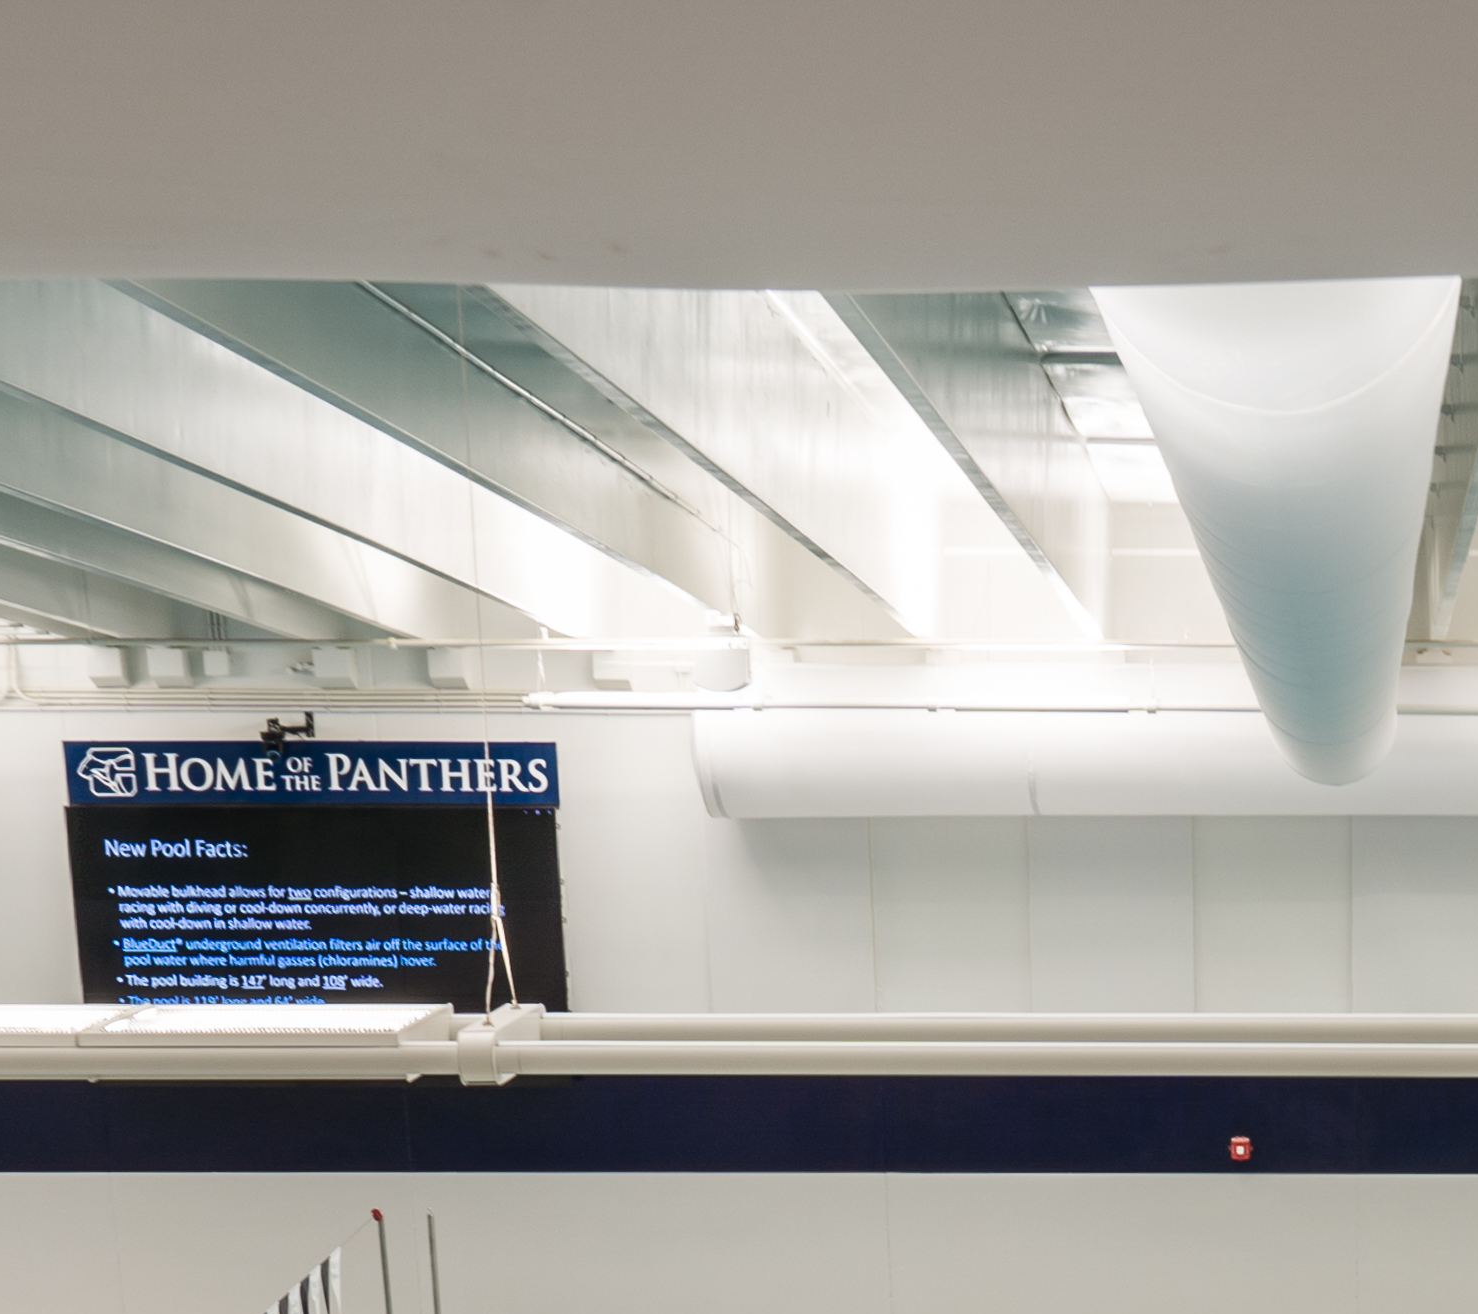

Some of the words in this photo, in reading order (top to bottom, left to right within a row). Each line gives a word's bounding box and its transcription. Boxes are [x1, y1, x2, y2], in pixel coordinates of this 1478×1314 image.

[140, 752, 277, 792] HOME
[286, 757, 313, 773] OF
[324, 753, 550, 793] PANTHERS
[280, 774, 322, 792] THE
[104, 838, 146, 858] New
[150, 838, 192, 858] Pool
[195, 838, 249, 858] Facts:
[117, 885, 170, 899] Movable
[172, 885, 227, 899] bulkhead
[228, 885, 266, 899] allows
[268, 885, 285, 899] for
[288, 887, 312, 899] two
[314, 885, 398, 901] configurations
[409, 886, 455, 899] shallow
[457, 886, 491, 899] water
[119, 901, 156, 916] racing
[157, 901, 184, 914] with
[186, 901, 223, 916] diving
[224, 904, 237, 914] or
[239, 901, 302, 914] cool-down
[304, 901, 382, 917] concurrently,
[383, 904, 397, 914] or
[398, 901, 466, 917] deep-water
[469, 902, 506, 917] racig
[119, 917, 148, 930] with
[149, 917, 212, 930] cool-down
[214, 917, 226, 930] in
[228, 917, 273, 930] shallow
[274, 918, 312, 930] water.
[185, 937, 262, 953] underground
[263, 938, 327, 951] ventilation
[329, 938, 363, 951] filters
[365, 938, 381, 951] air
[383, 938, 401, 951] off
[402, 938, 422, 951] the
[424, 938, 467, 951] surface
[470, 938, 484, 951] of
[124, 954, 152, 968] pool
[153, 955, 187, 966] water
[189, 954, 228, 966] where
[229, 953, 276, 966] harmful
[277, 957, 316, 969] gasses
[318, 954, 398, 969] (chloramines)
[399, 954, 437, 967] hover.
[125, 974, 150, 987] The
[151, 974, 178, 989] pool
[179, 974, 228, 989] building
[229, 974, 240, 987] is
[269, 974, 296, 989] long
[297, 974, 321, 987] and
[350, 975, 384, 988] wide.
[127, 995, 151, 1004] The
